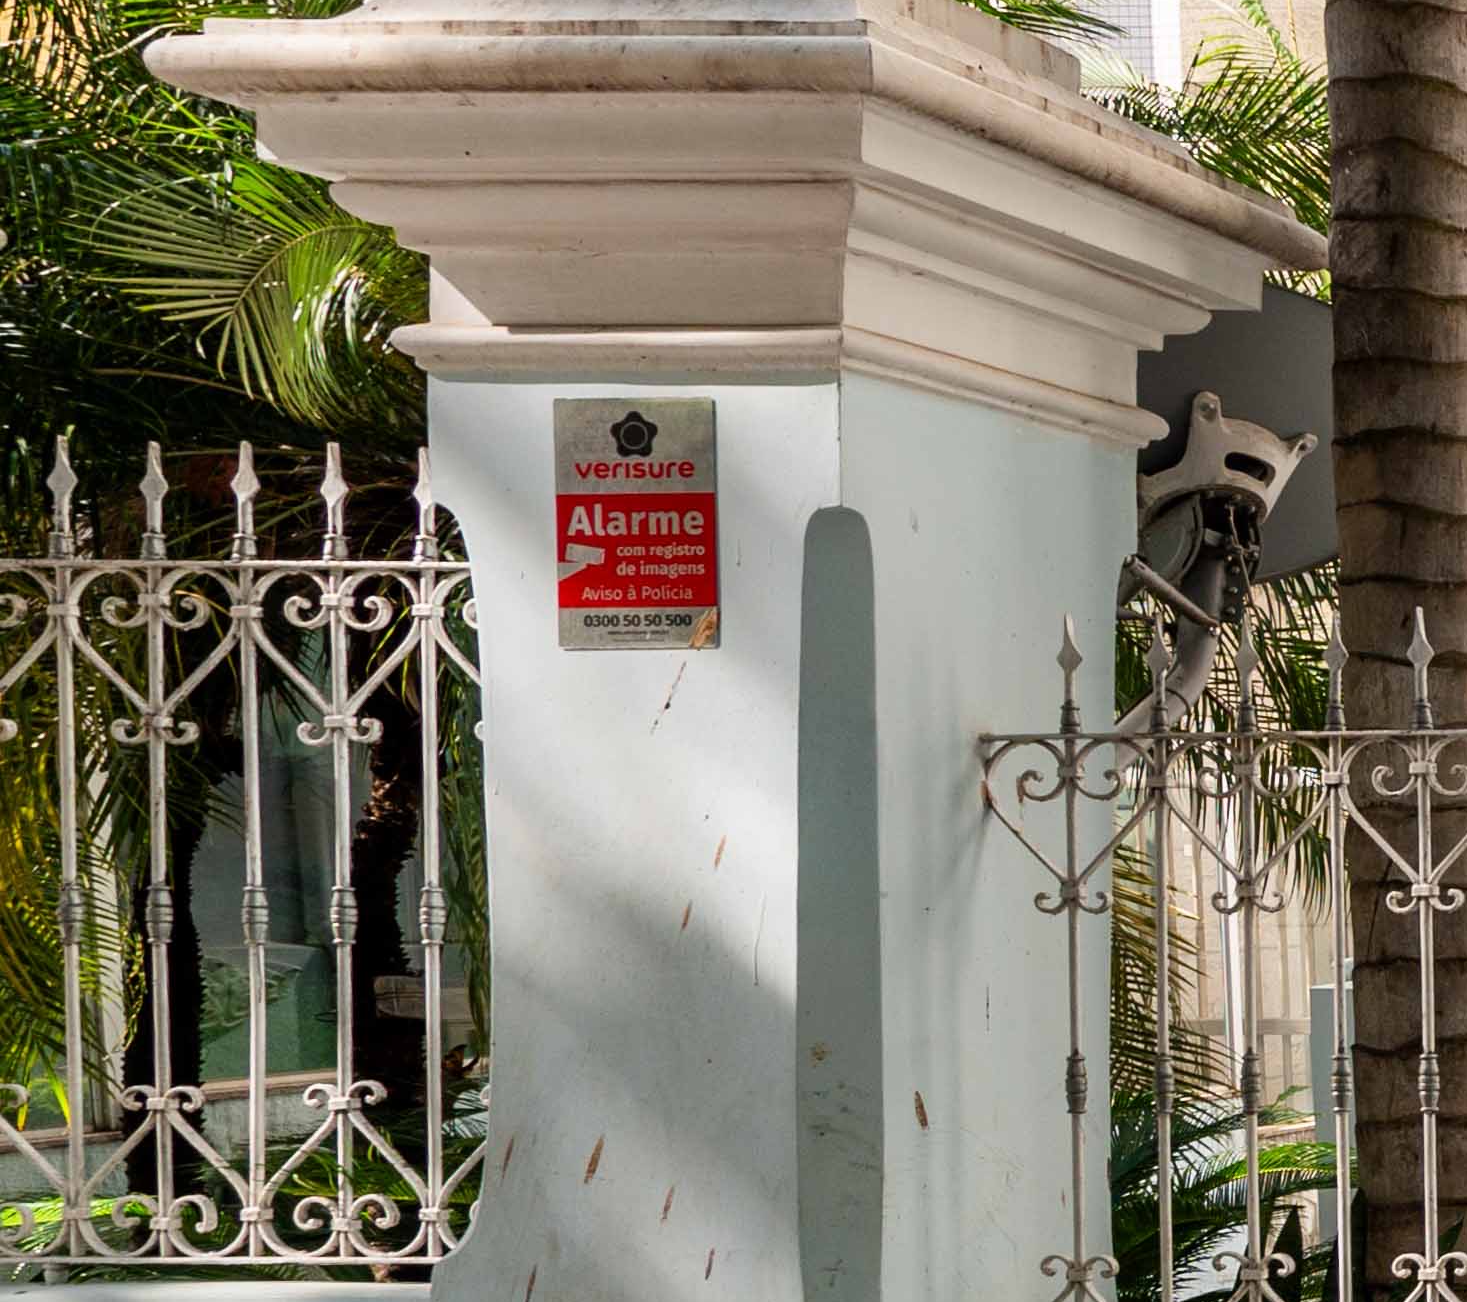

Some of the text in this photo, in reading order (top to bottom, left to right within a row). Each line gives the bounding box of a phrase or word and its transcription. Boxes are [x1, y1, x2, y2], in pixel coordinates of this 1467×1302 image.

[575, 461, 695, 479] verisure
[567, 503, 704, 536] Alarme
[617, 542, 705, 559] com registro
[616, 561, 705, 579] de imagens
[582, 584, 693, 600] Aviso à Polícia
[584, 614, 693, 627] 0300 50 50 500
